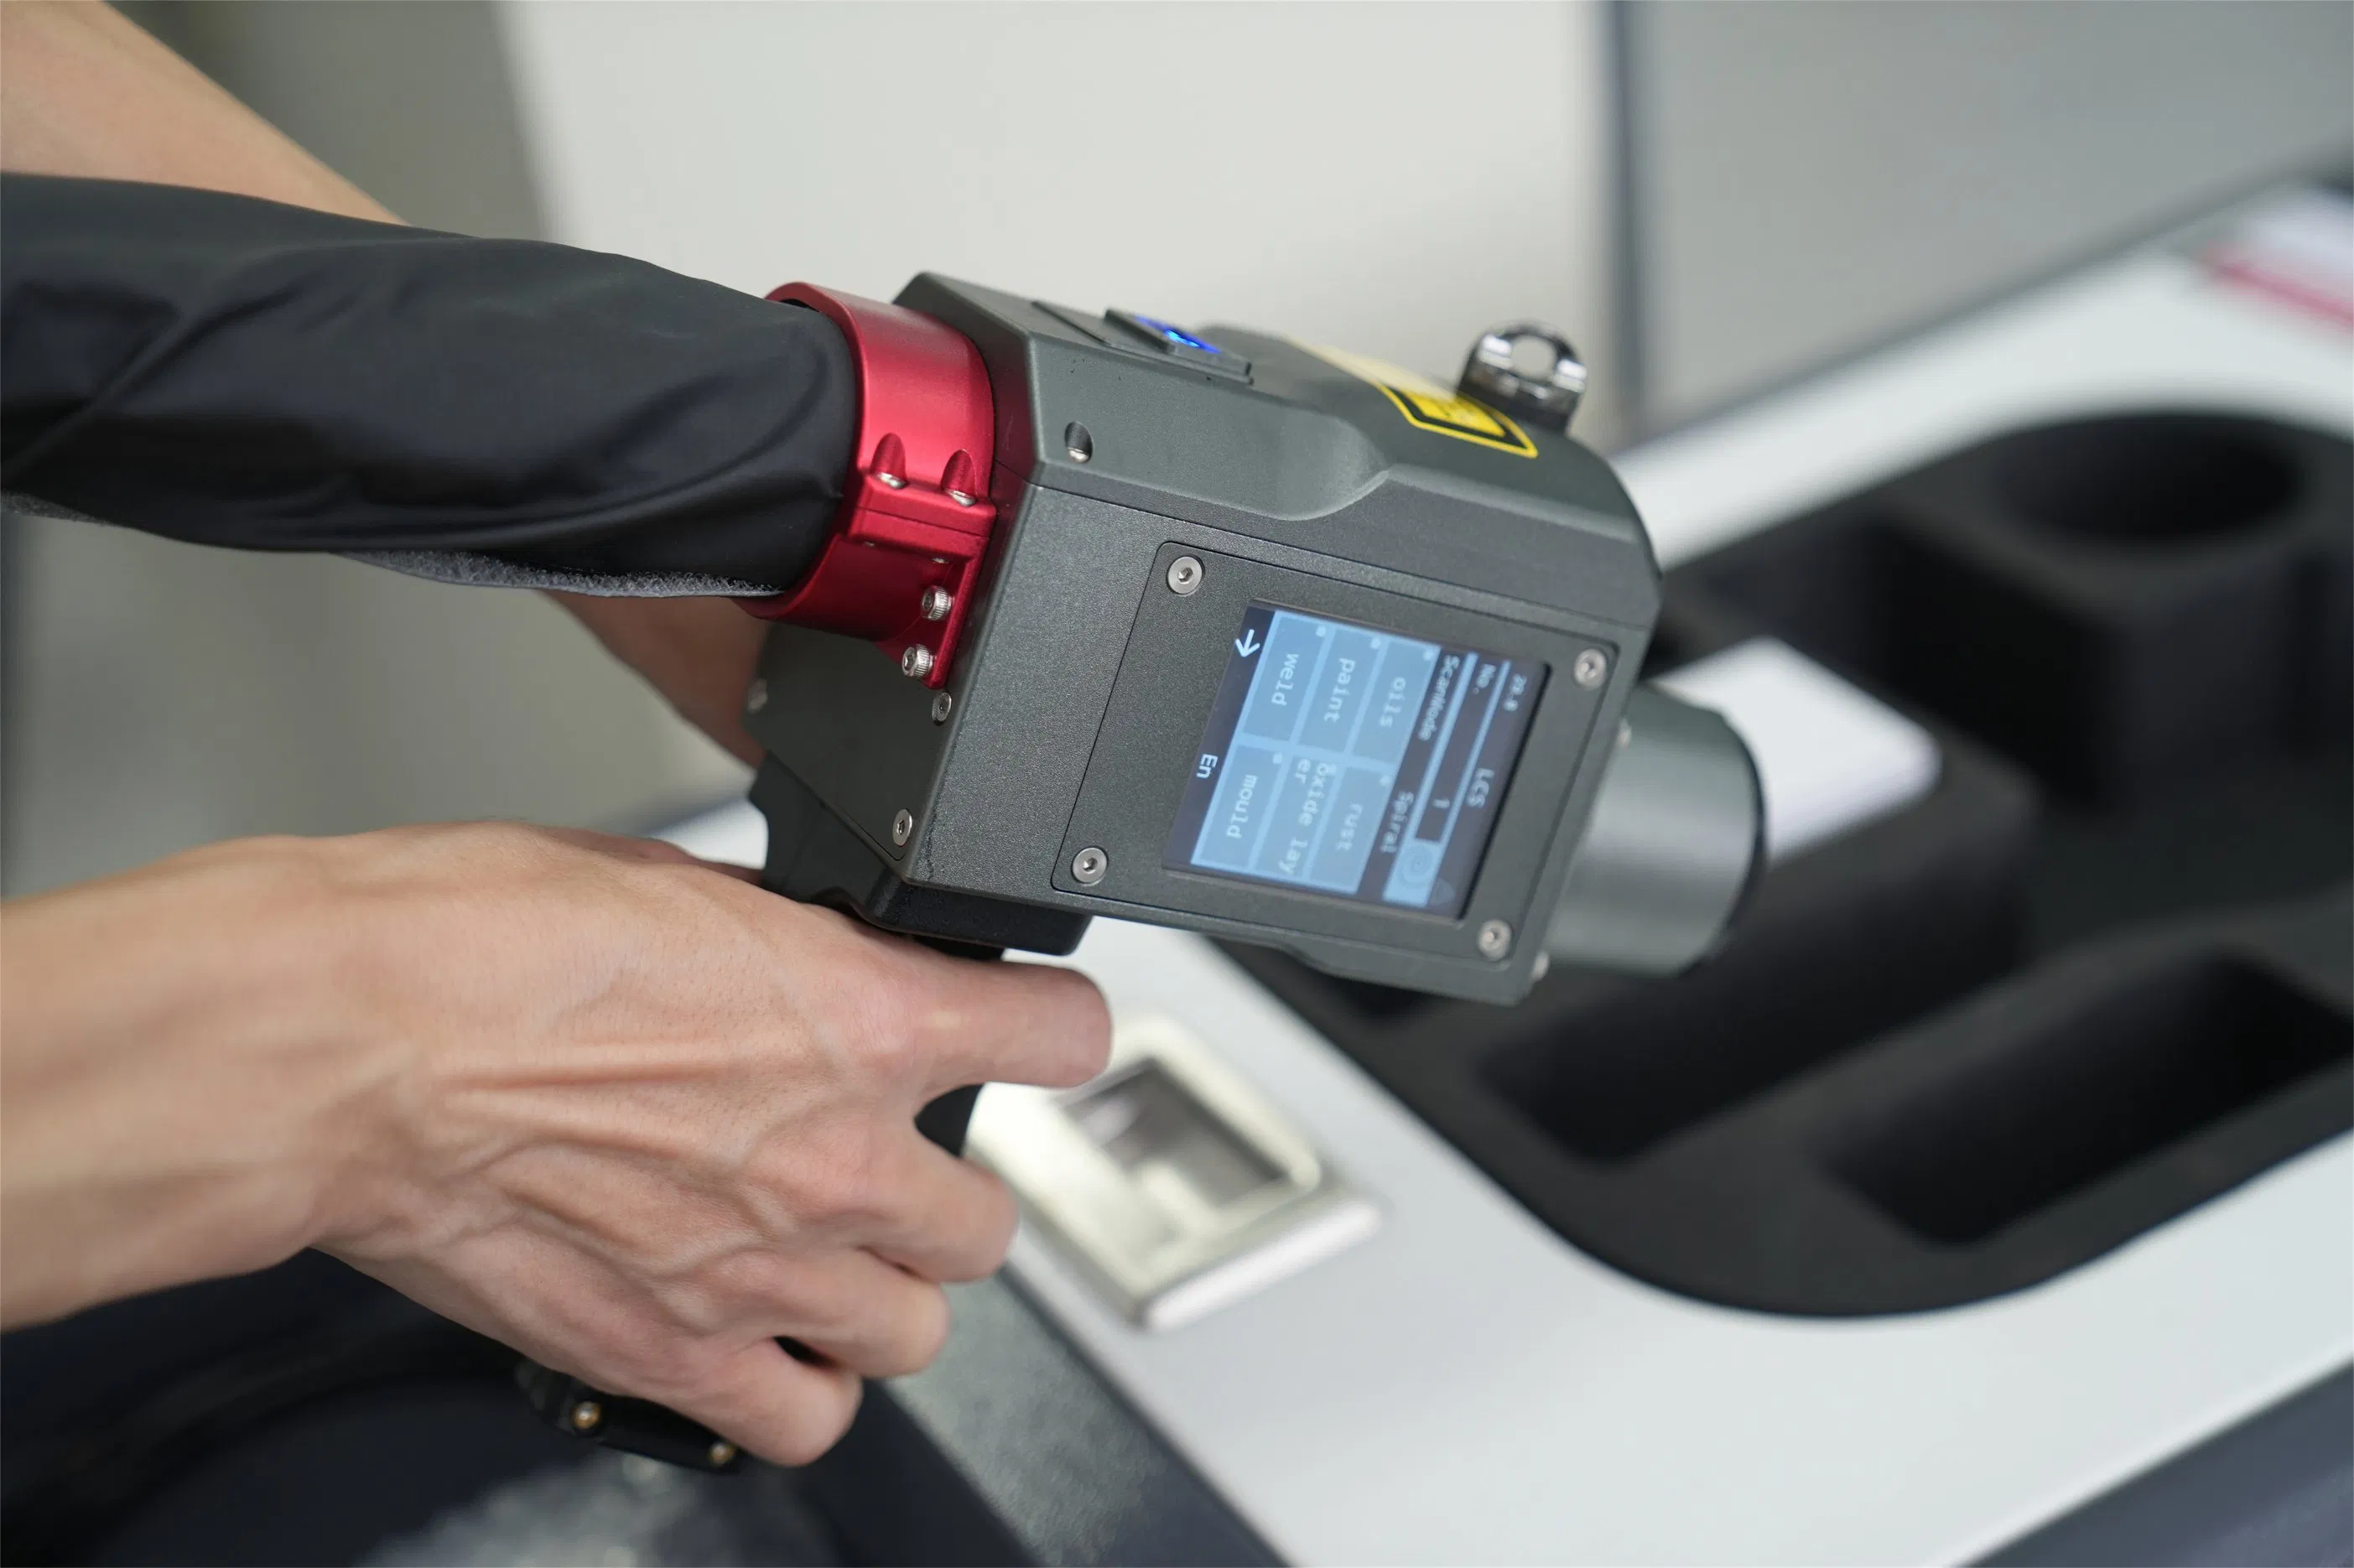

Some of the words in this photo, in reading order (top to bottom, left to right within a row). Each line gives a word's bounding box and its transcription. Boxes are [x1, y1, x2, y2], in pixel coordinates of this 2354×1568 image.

[1271, 652, 1300, 707] weld
[1324, 657, 1355, 724] paint
[1380, 677, 1406, 729] oils
[1196, 753, 1219, 779] En
[1294, 758, 1312, 782] er
[1226, 774, 1258, 839] mould
[1297, 761, 1329, 826] oxide
[1338, 802, 1363, 851] rust
[1380, 791, 1415, 854] Spiral
[1279, 836, 1308, 875] lay
